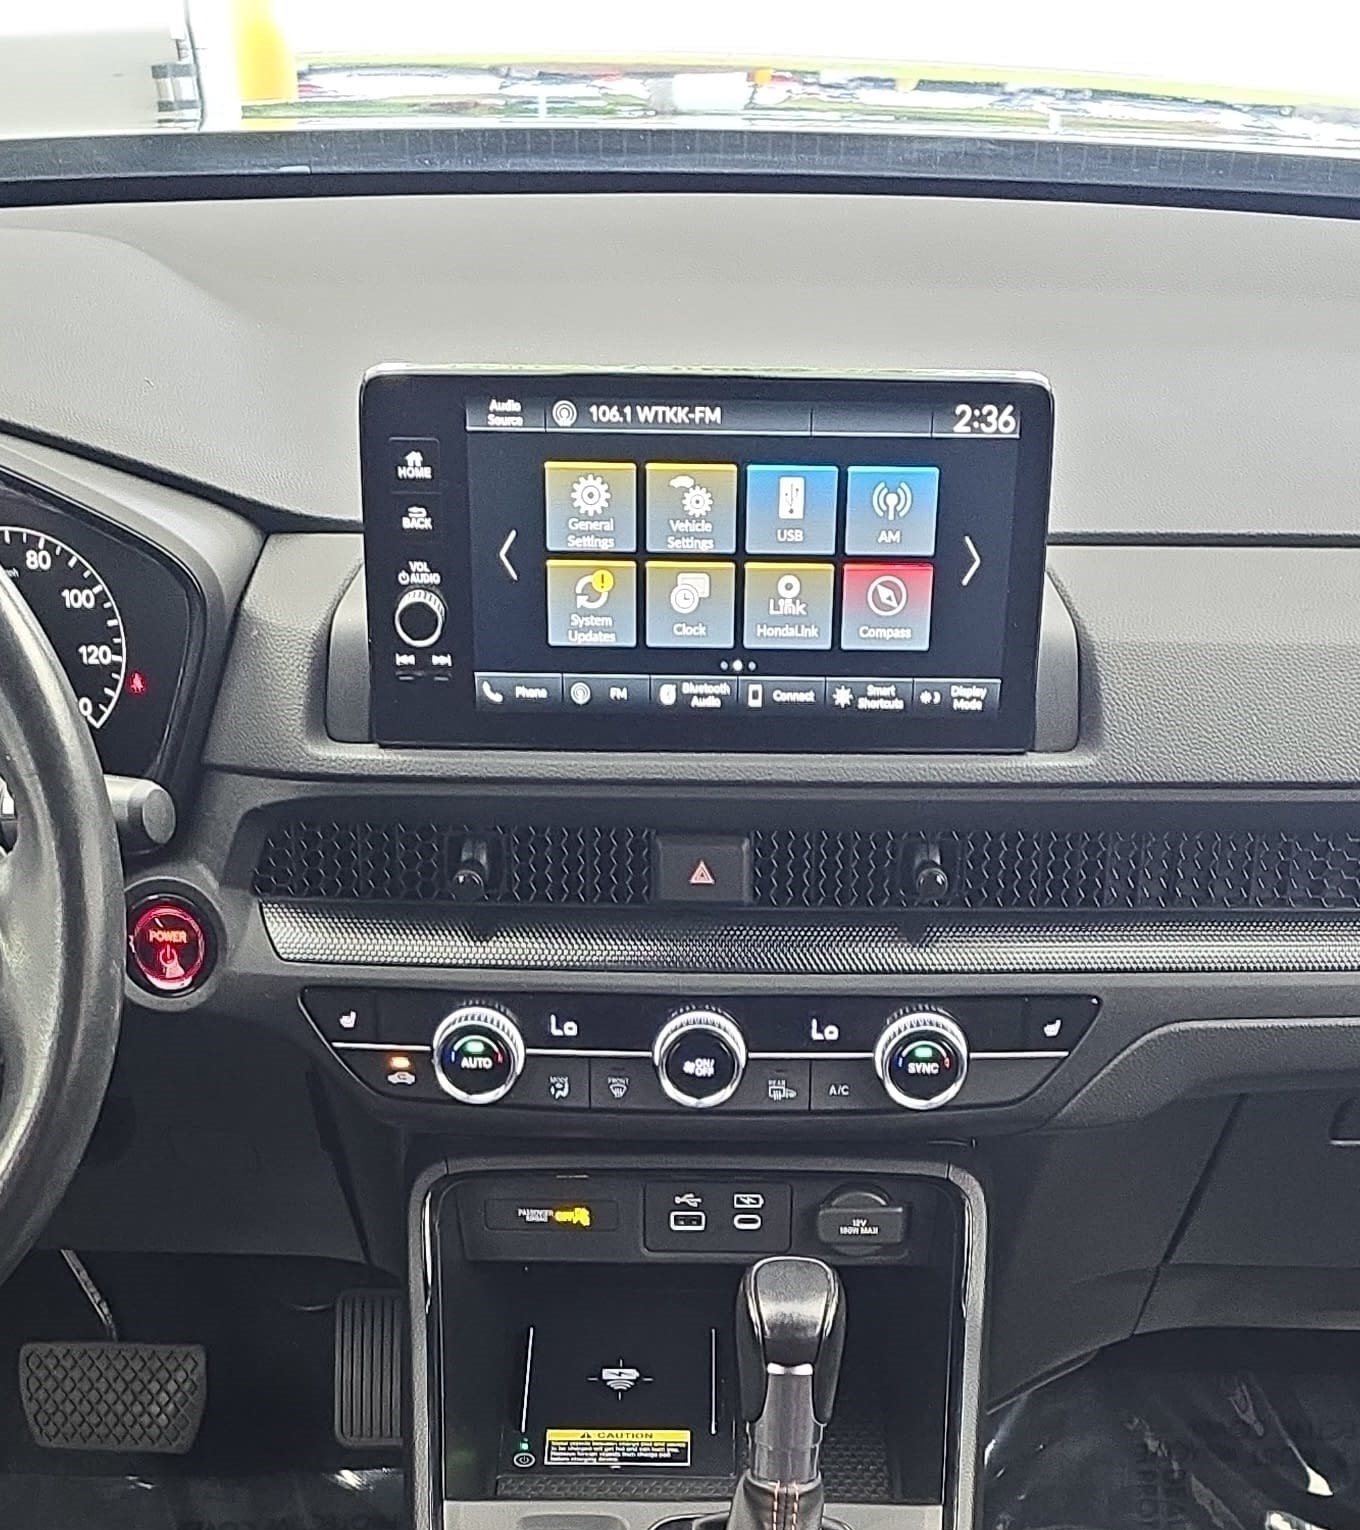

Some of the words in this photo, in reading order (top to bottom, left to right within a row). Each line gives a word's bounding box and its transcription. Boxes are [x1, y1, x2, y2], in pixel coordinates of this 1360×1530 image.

[488, 399, 521, 412] Audio
[487, 413, 523, 427] Source
[589, 405, 632, 424] 106.1
[636, 406, 722, 424] WTKK-FM
[952, 403, 1016, 433] 2:36
[397, 466, 432, 480] HOME
[401, 516, 433, 531] BACK
[567, 518, 614, 532] General
[668, 519, 713, 533] Vehicle
[566, 534, 615, 550] Settings
[776, 528, 805, 543] USB
[877, 530, 902, 545] AM
[667, 536, 715, 551] Settings
[25, 550, 52, 570] 80
[408, 561, 431, 573] VOL
[409, 572, 441, 584] AUDIO
[61, 588, 95, 609] 100
[569, 614, 613, 630] System
[672, 623, 707, 637] Clock
[756, 624, 820, 639] HondaLink
[859, 625, 912, 641] Compass
[567, 630, 616, 645] Updates
[78, 645, 112, 666] 120
[514, 685, 548, 699] Phone
[609, 687, 628, 700] FM
[681, 682, 731, 696] Bluetooth
[772, 689, 815, 703] Connect
[866, 684, 897, 698] Smart
[950, 685, 987, 700] Display
[690, 695, 722, 709] Audio
[857, 697, 905, 710] Shortcuts
[952, 699, 983, 711] Mode
[149, 929, 188, 944] POWER
[550, 1013, 578, 1037] Lo
[811, 1018, 840, 1041] Lo
[460, 1057, 493, 1070] AUTO
[907, 1062, 940, 1075] SYNC
[695, 1067, 715, 1077] OFF
[828, 1085, 850, 1096] A/C
